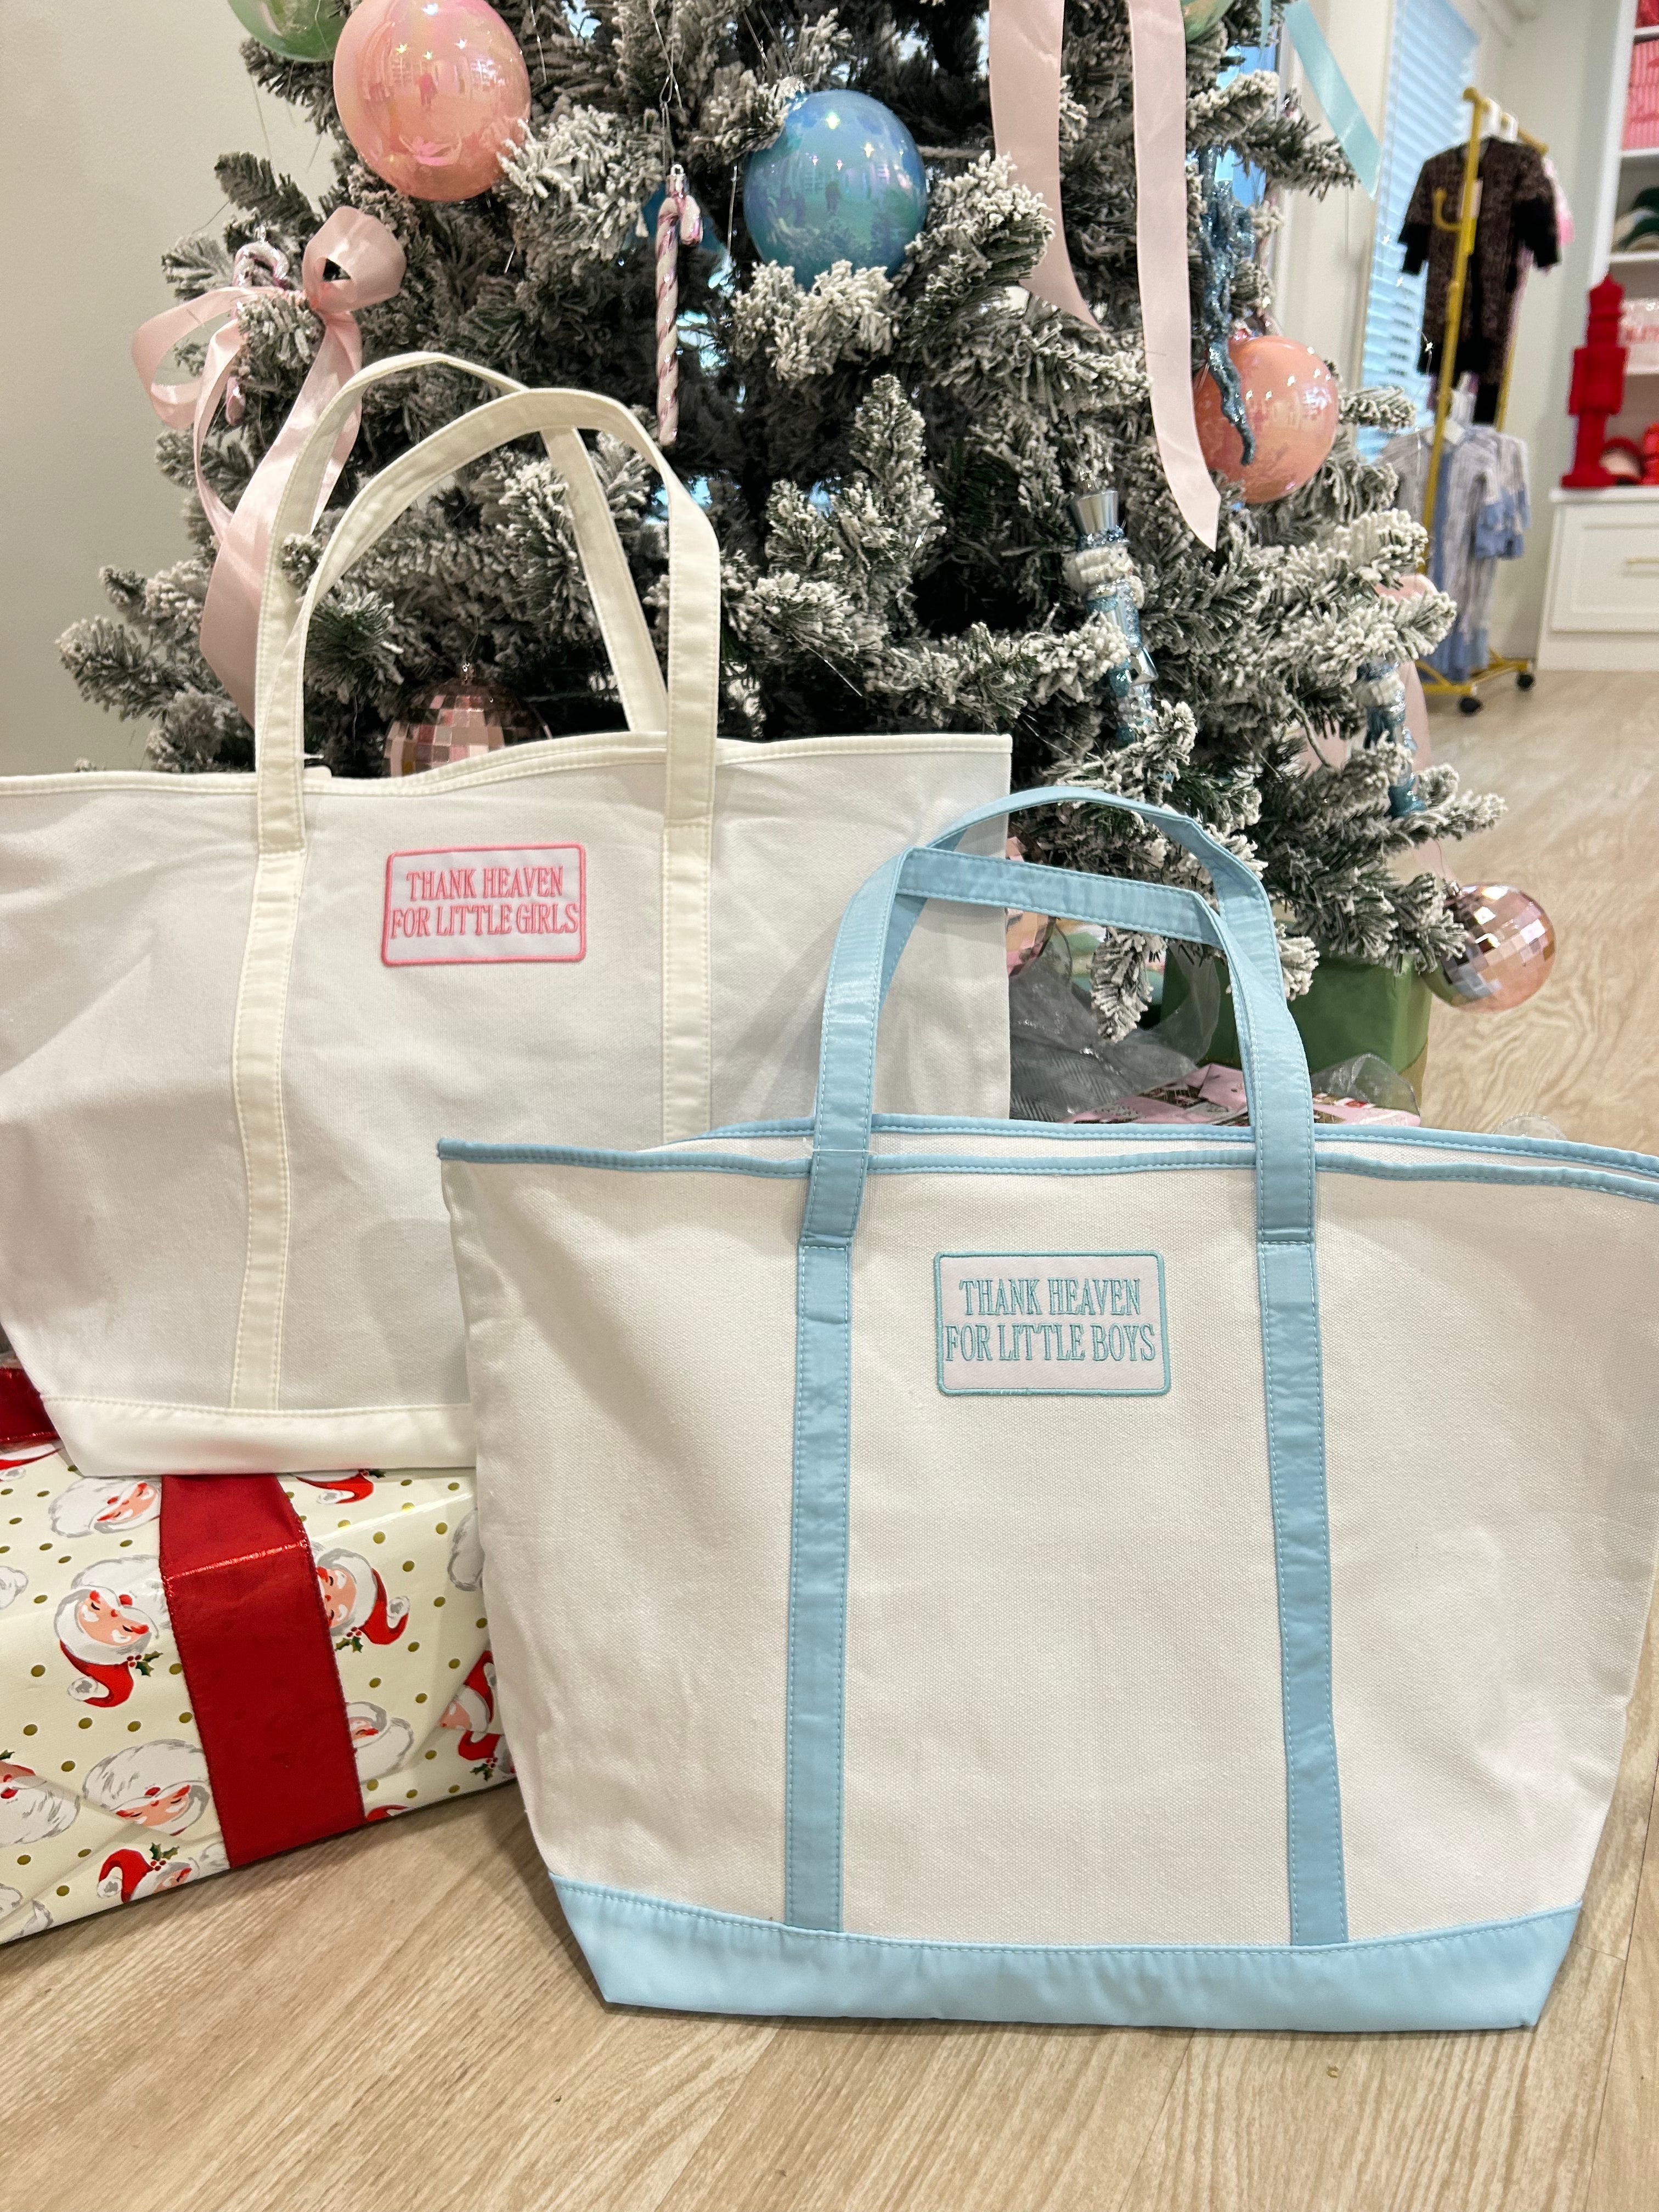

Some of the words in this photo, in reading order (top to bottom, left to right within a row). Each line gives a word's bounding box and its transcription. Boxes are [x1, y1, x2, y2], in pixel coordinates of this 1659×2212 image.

[407, 868, 476, 901] THANK
[483, 865, 563, 898] HEAVEN
[391, 907, 431, 939] FOR
[436, 903, 512, 936] LITTLE
[516, 902, 579, 934] GIRLS
[959, 1277, 1042, 1316] THANK
[1047, 1277, 1141, 1316] HEAVEN
[945, 1323, 992, 1361] FOR
[997, 1323, 1086, 1361] LITTLE
[1090, 1323, 1155, 1361] BOYS
